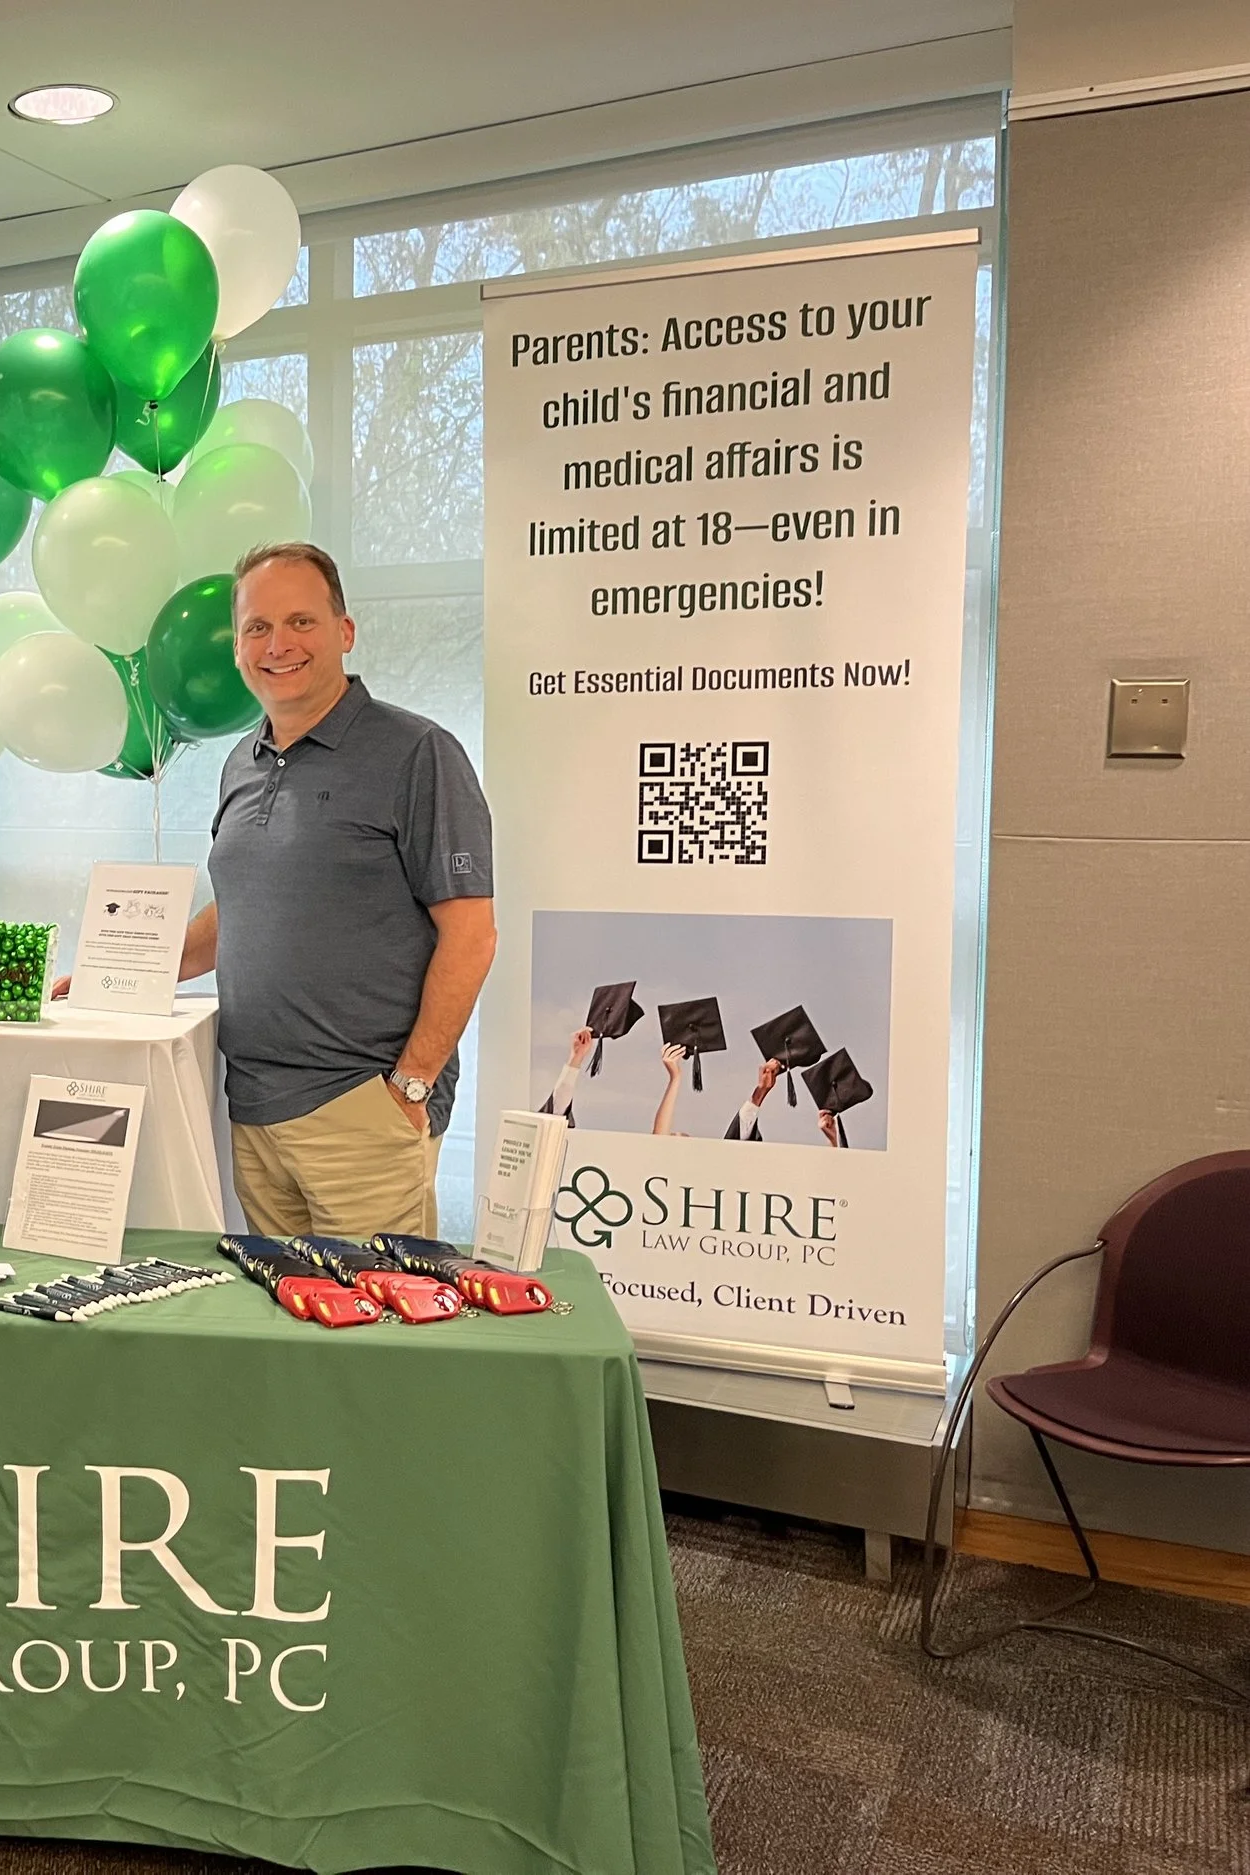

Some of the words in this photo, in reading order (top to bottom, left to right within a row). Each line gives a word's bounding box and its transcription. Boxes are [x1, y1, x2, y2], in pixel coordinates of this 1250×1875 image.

[512, 324, 649, 368] Parents:
[661, 310, 787, 352] Access
[798, 303, 835, 337] to
[846, 295, 932, 340] your
[543, 385, 651, 429] child's
[662, 368, 811, 418] financial
[824, 361, 890, 404] and
[564, 445, 693, 491] medical
[705, 438, 819, 480] affairs
[832, 433, 863, 471] is
[529, 515, 640, 557] limited
[651, 514, 687, 549] at
[868, 499, 900, 537] in
[591, 570, 823, 619] emergencies!
[529, 671, 567, 696] Get
[574, 665, 683, 694] Essential
[692, 663, 835, 691] Documents
[844, 658, 910, 687] Now!
[642, 1229, 691, 1252] LAW
[699, 1235, 790, 1263] GROUP,
[802, 1244, 836, 1267] PC
[713, 1284, 796, 1314] Client
[808, 1294, 906, 1326] Driven
[221, 1638, 327, 1712] PC
